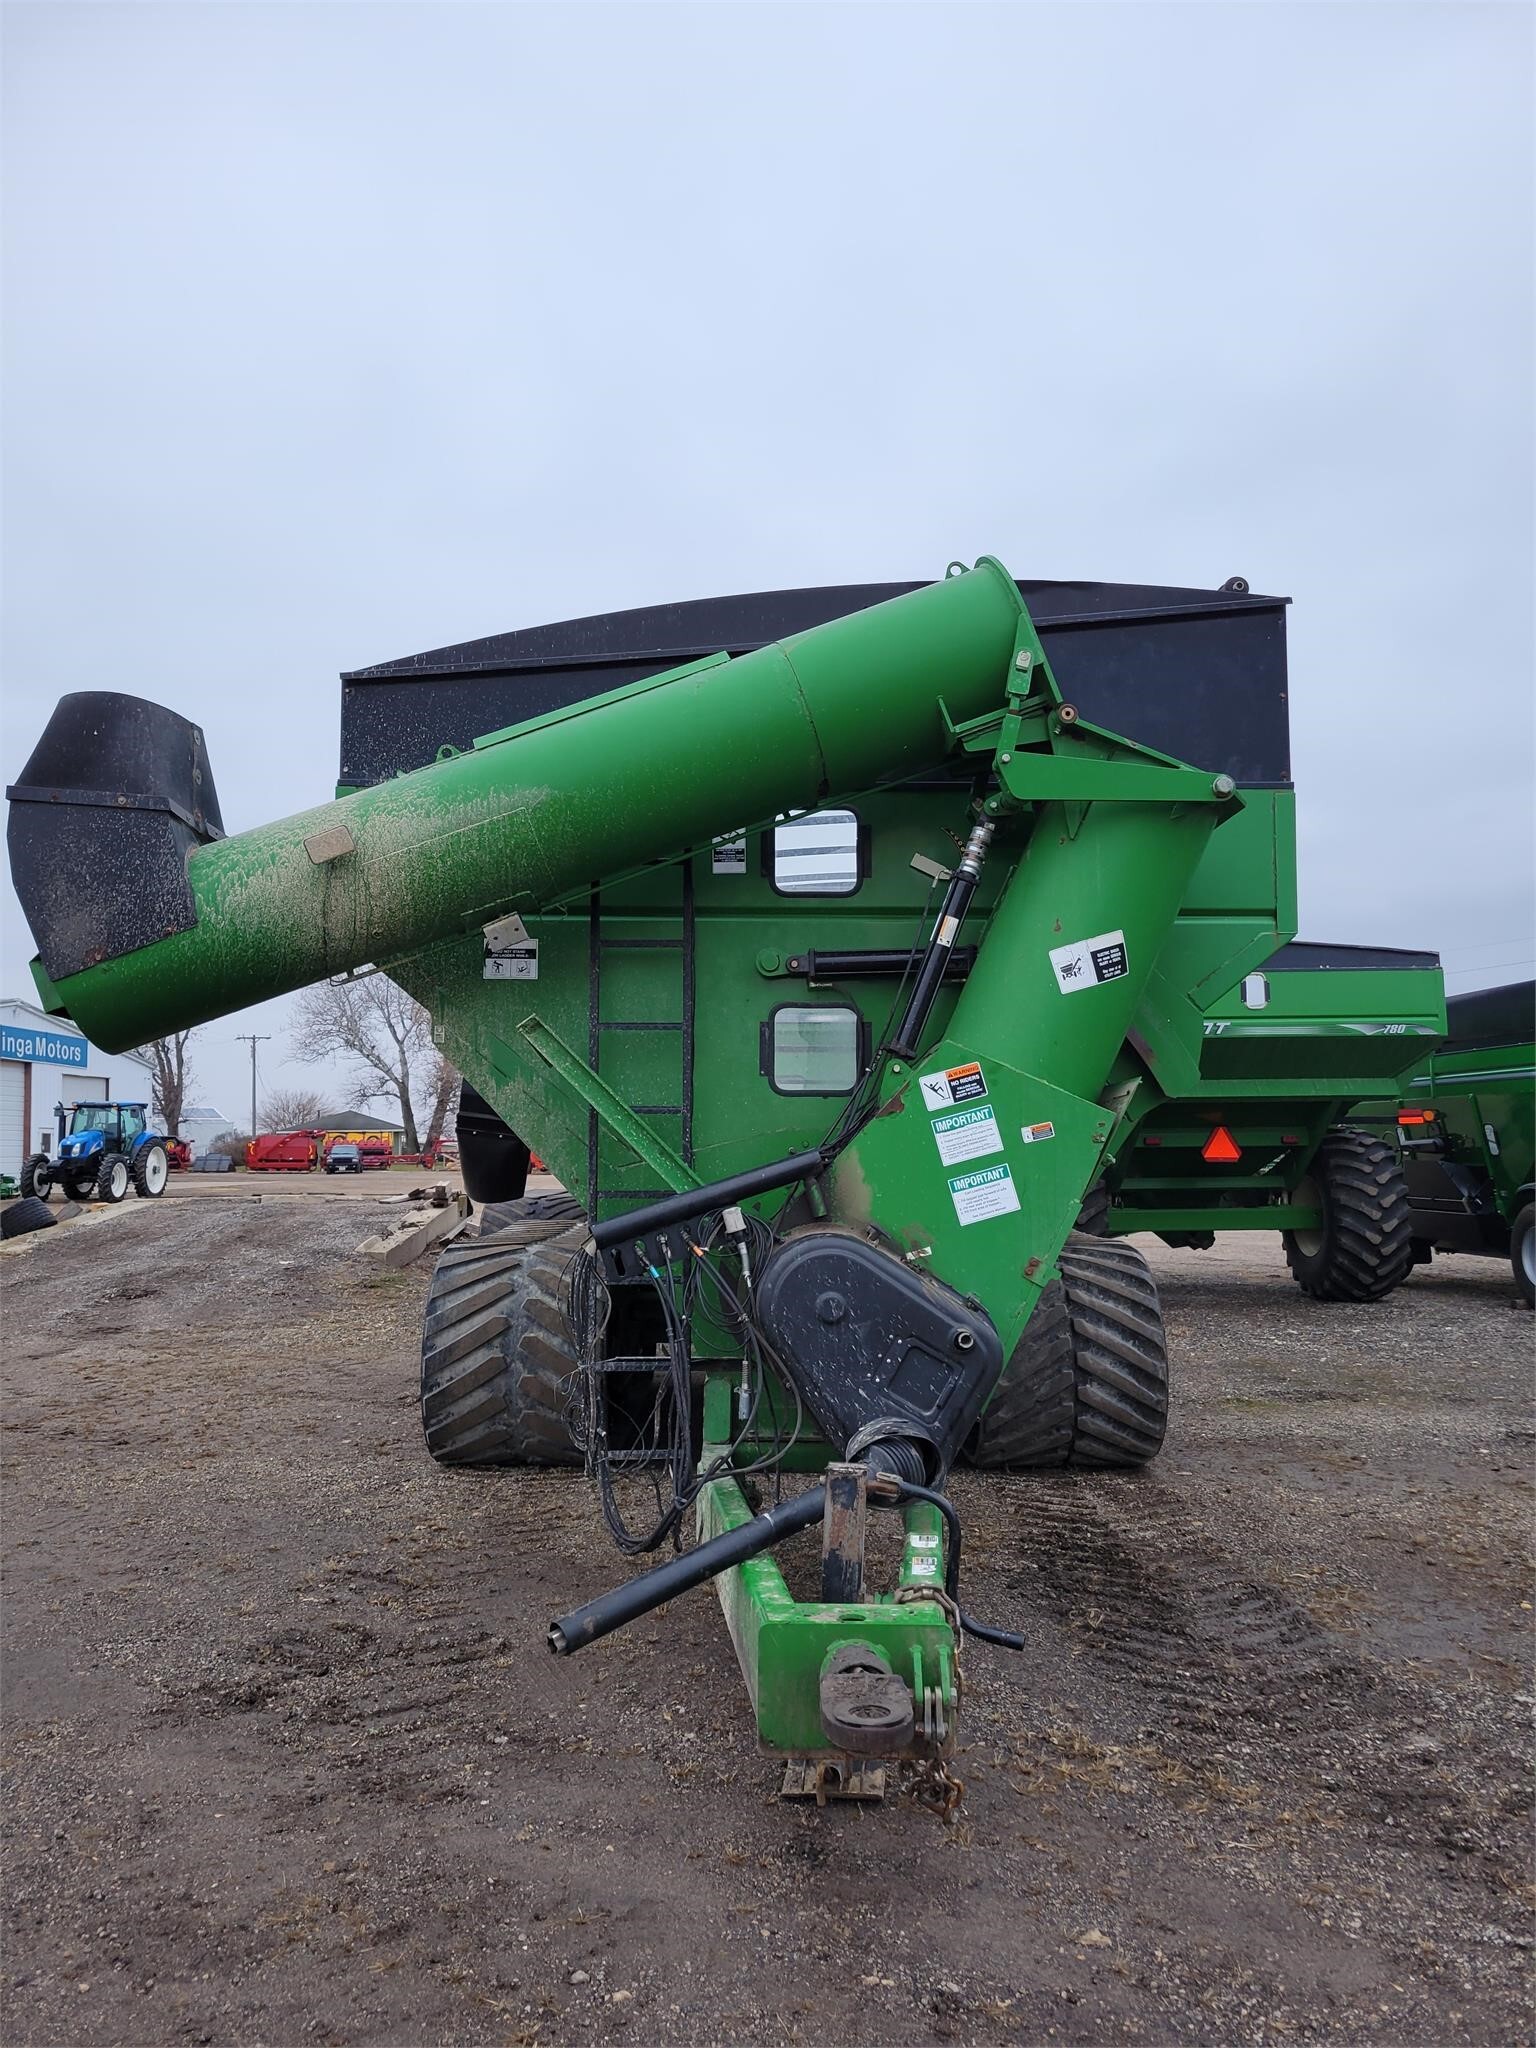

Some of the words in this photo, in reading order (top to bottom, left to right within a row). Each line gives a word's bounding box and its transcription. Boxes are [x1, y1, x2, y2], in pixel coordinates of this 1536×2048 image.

[35, 1037, 81, 1061] Motors
[935, 1108, 990, 1132] IMPORTANT
[953, 1167, 1004, 1191] IMPORTANT
